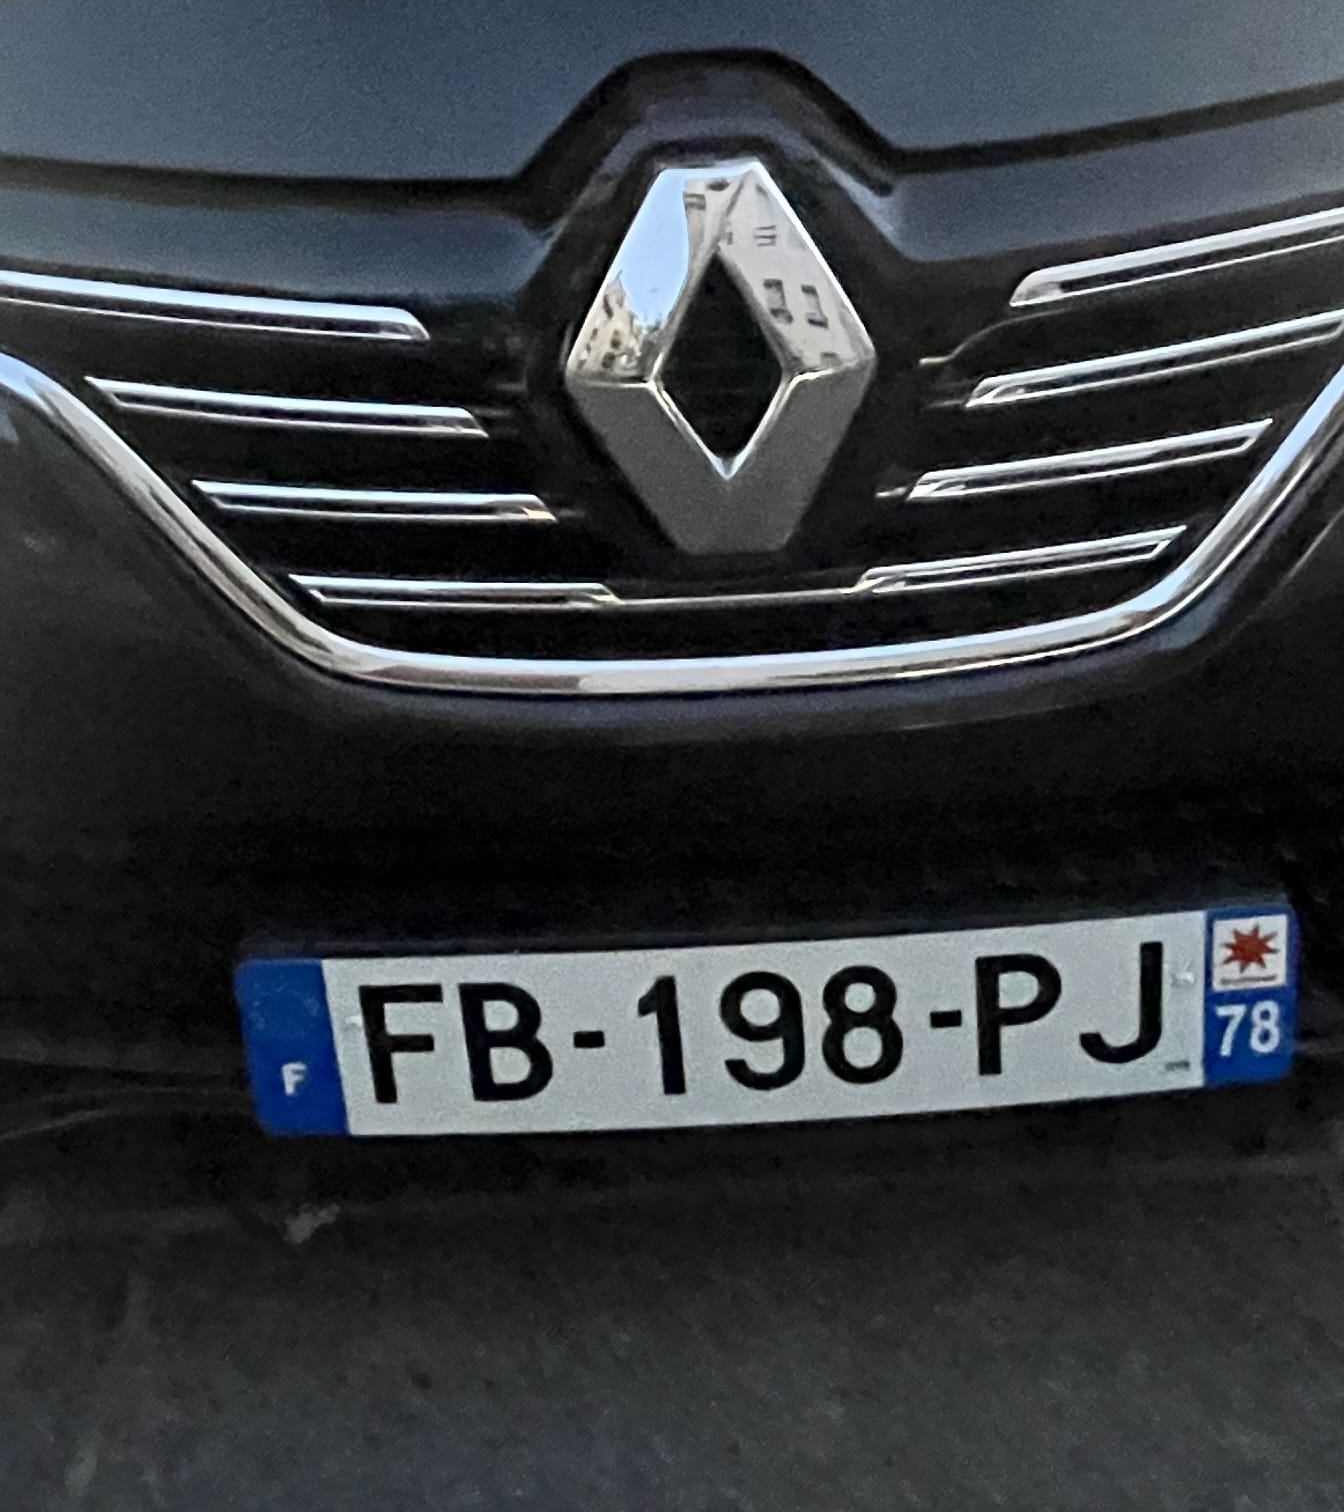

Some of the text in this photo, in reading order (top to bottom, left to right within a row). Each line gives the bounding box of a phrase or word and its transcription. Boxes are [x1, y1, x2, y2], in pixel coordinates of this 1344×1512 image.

[358, 940, 1164, 1105] FB-198-PJ
[1215, 1000, 1280, 1057] 78
[281, 1061, 307, 1097] F
